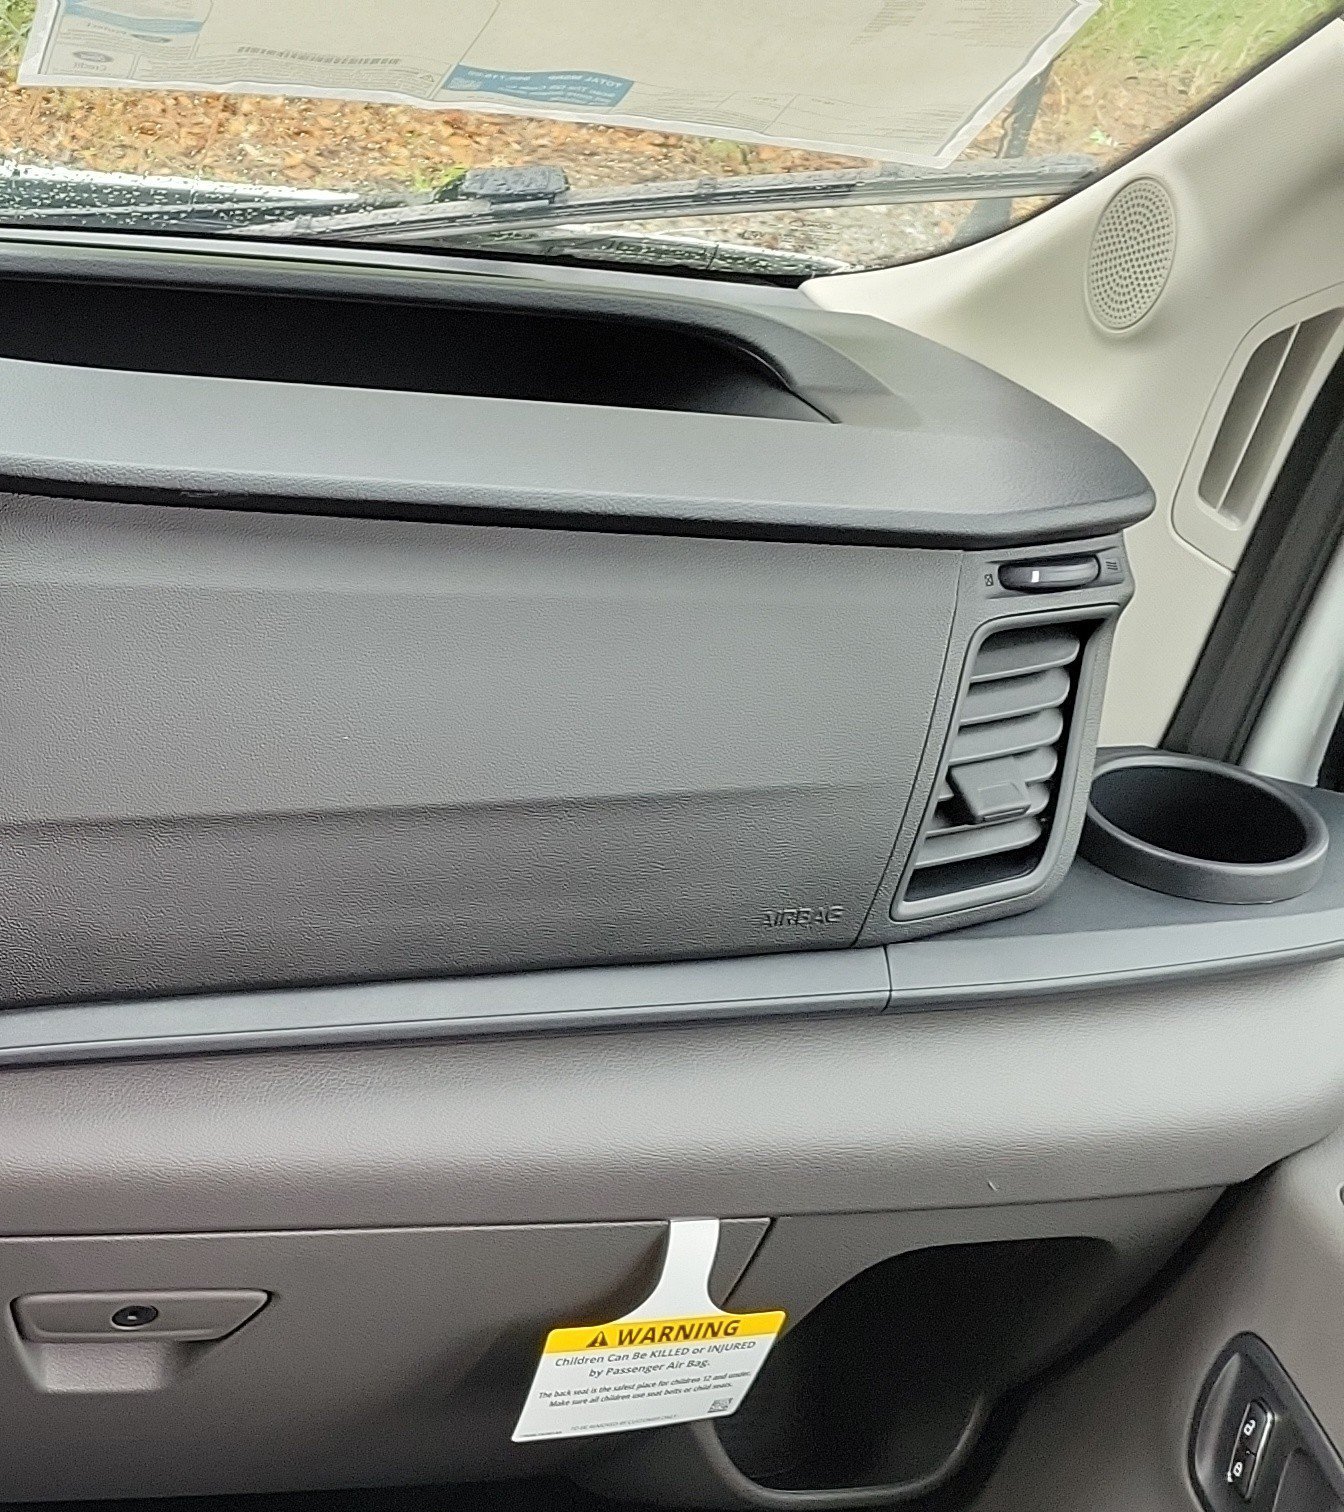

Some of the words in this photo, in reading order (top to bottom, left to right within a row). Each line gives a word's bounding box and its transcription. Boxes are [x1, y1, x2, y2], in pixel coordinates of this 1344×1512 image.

[762, 905, 845, 928] AIRBAG
[616, 1319, 741, 1346] WARNING
[555, 1351, 605, 1367] Children
[607, 1351, 630, 1363] Can
[632, 1350, 648, 1360] Be
[650, 1347, 689, 1358] KILLED
[691, 1347, 704, 1355] or
[706, 1341, 757, 1354] INJURED
[588, 1368, 603, 1378] by
[606, 1362, 664, 1376] Passenger
[666, 1360, 686, 1370] Air
